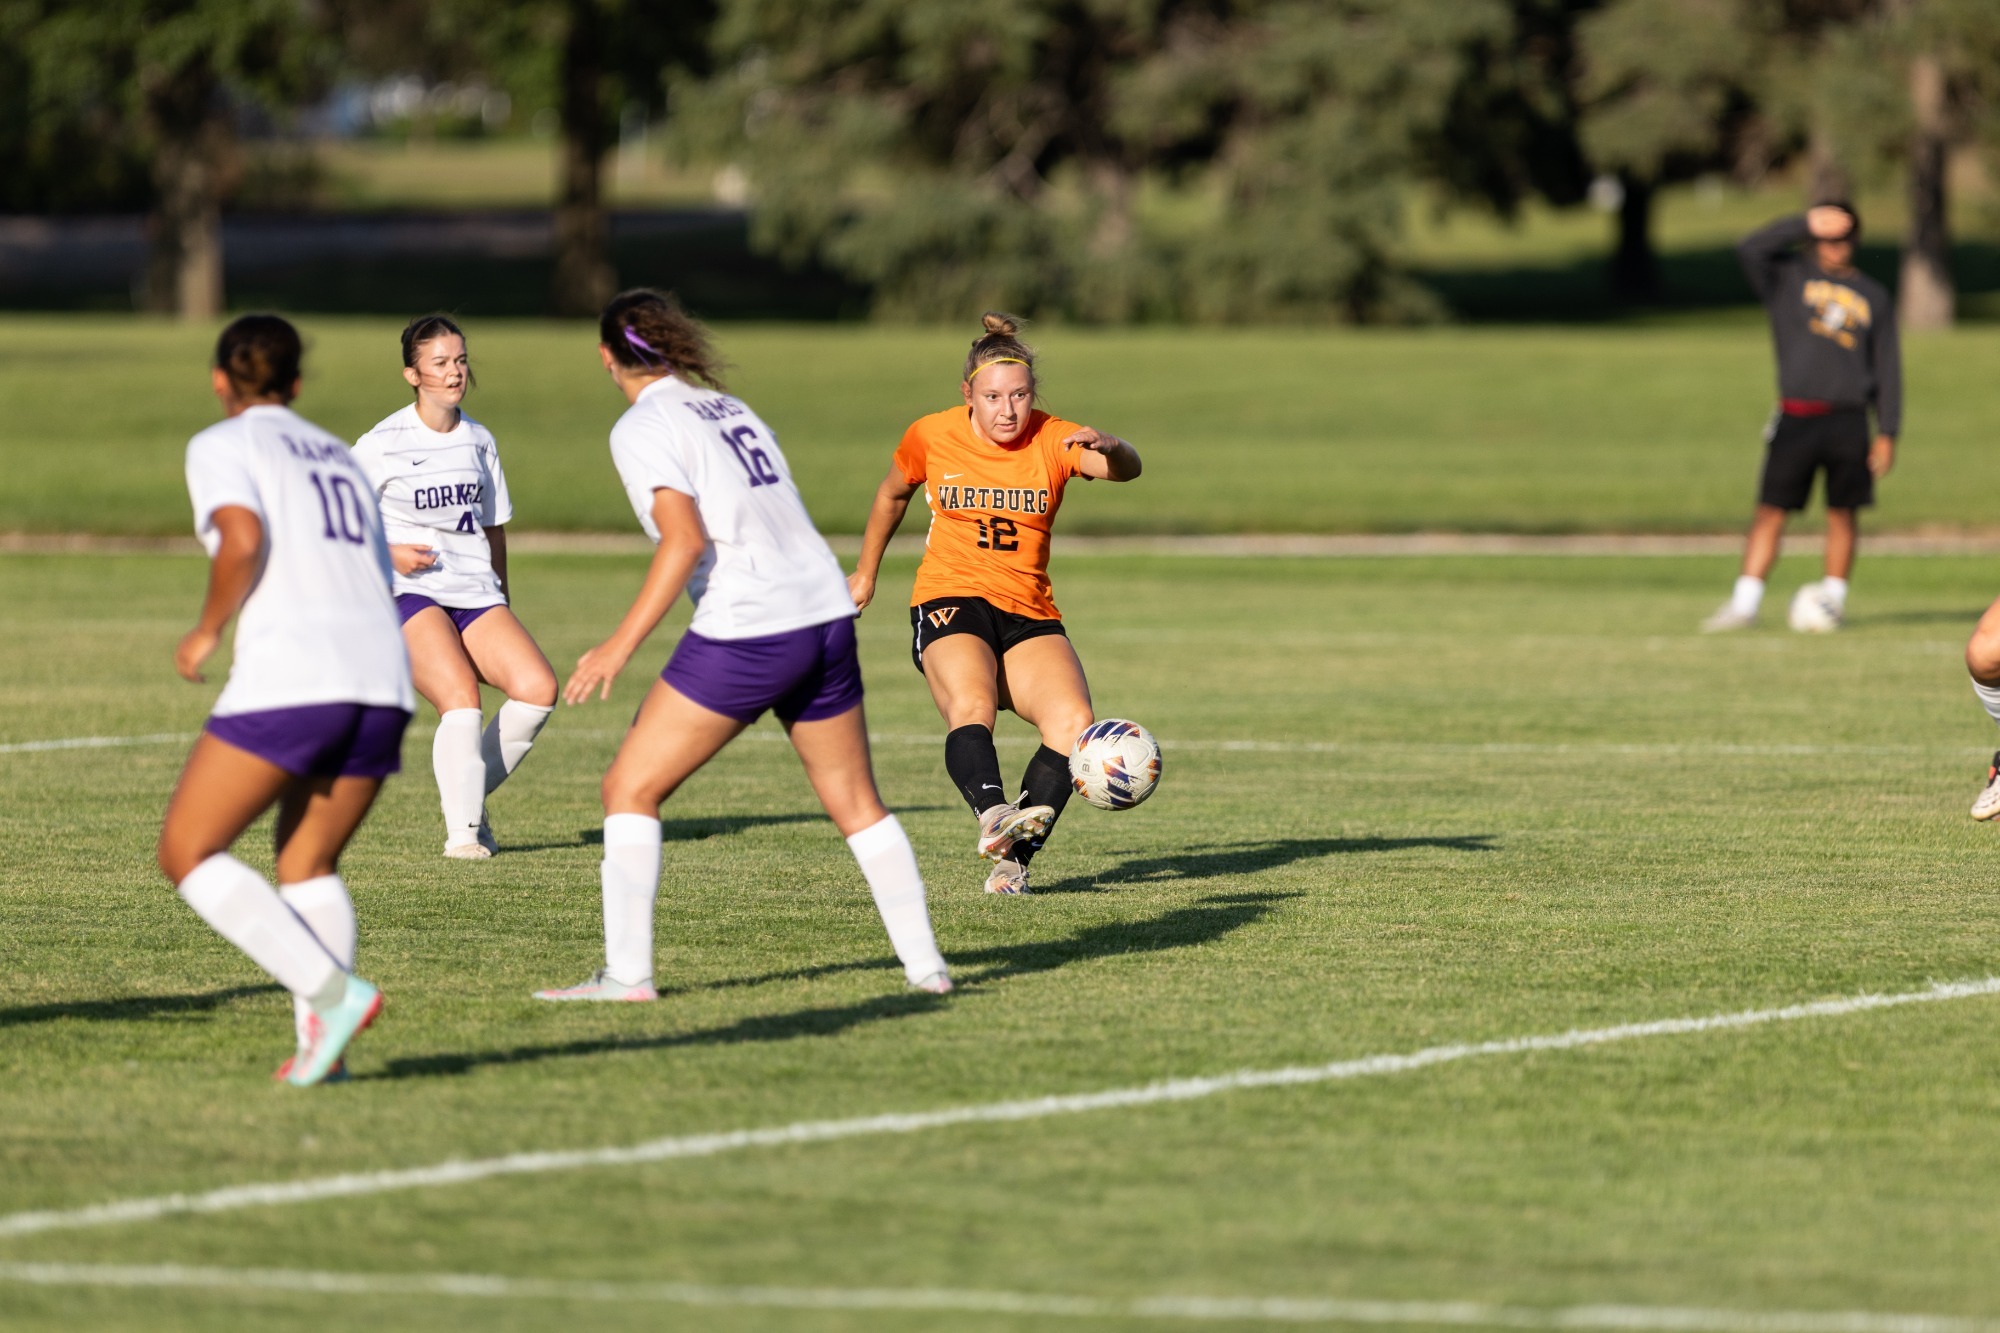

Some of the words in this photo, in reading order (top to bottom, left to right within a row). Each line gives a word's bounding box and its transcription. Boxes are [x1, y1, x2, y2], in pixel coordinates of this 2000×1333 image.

[720, 425, 779, 487] 16
[309, 470, 365, 544] 10
[938, 485, 1049, 515] WARTBURG
[455, 511, 476, 535] 4
[974, 516, 1019, 552] 12
[927, 606, 960, 629] W
